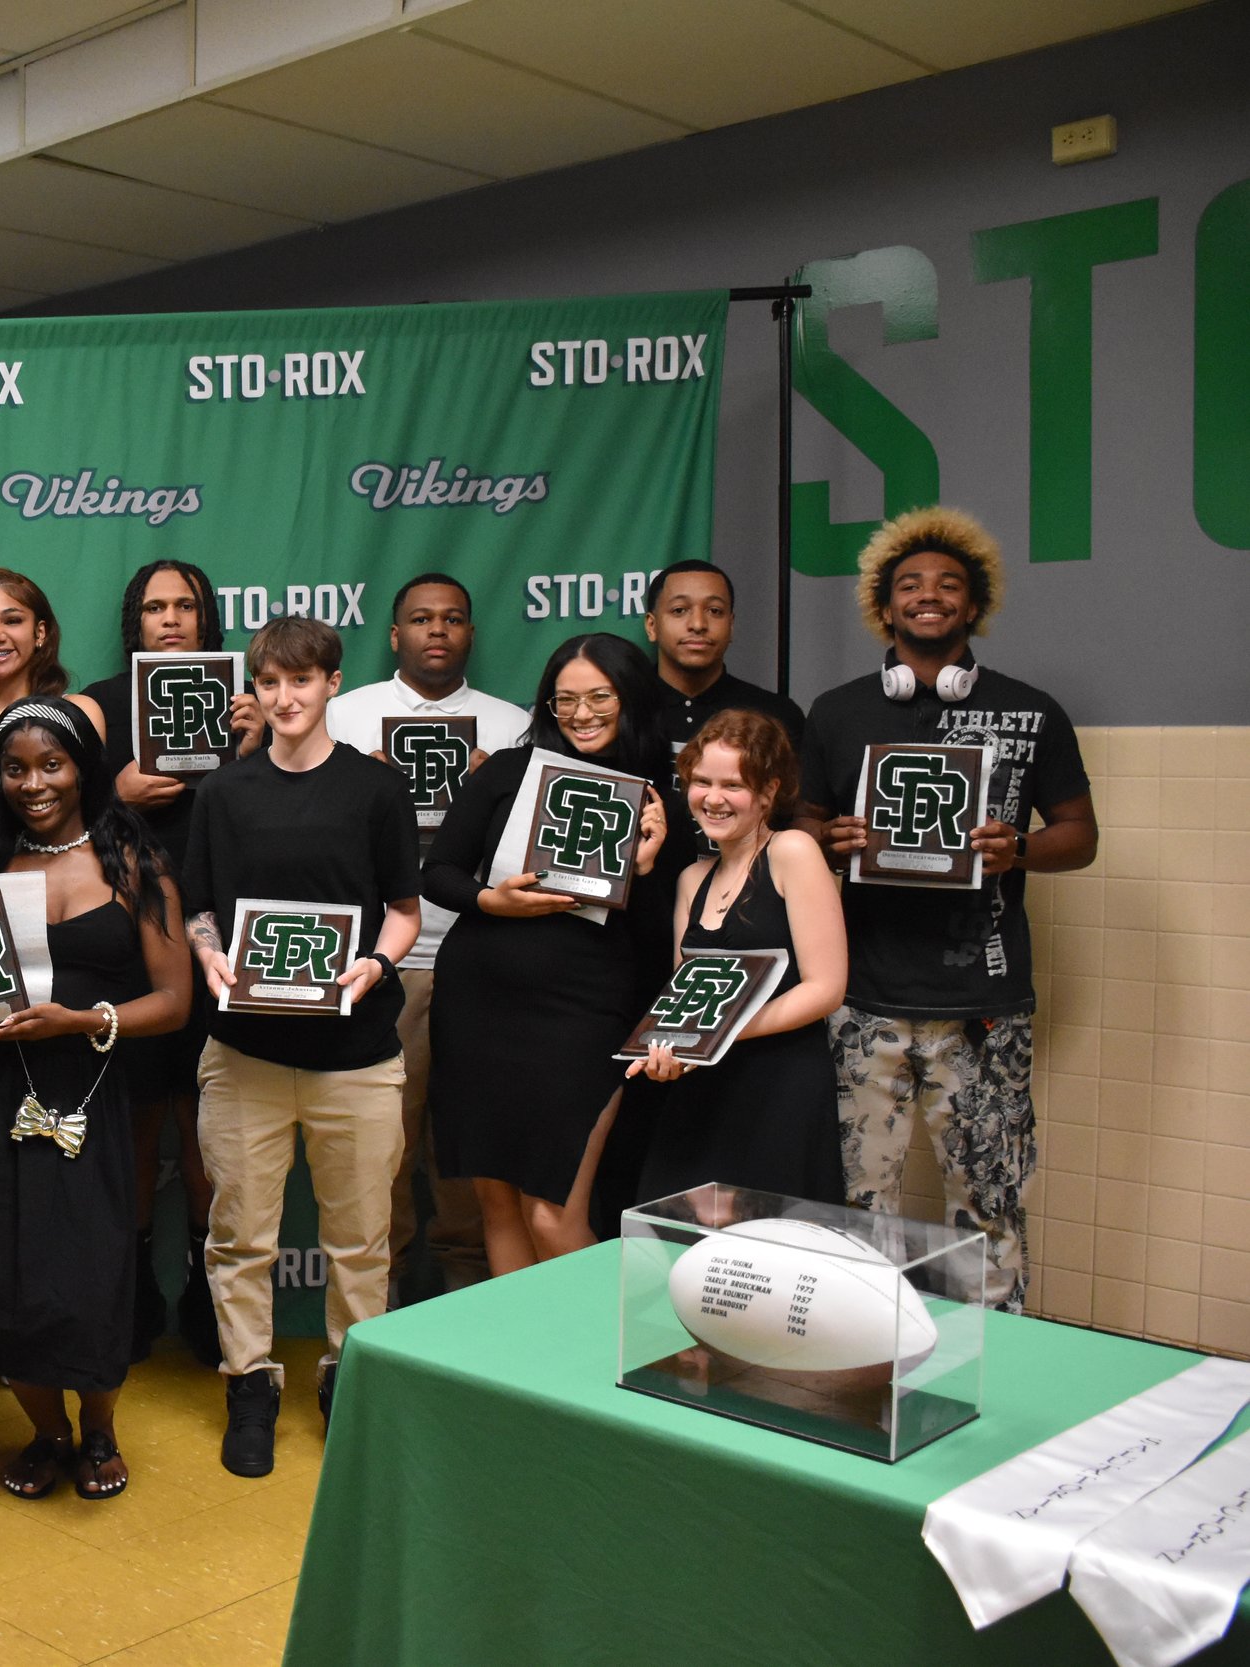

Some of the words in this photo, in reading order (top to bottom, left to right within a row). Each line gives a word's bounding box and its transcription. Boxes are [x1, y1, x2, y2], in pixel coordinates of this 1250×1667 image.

[0, 469, 201, 526] Vikings
[351, 459, 547, 514] Vikings
[936, 708, 1047, 734] ATHLETI
[999, 738, 1038, 764] EPT
[704, 1275, 728, 1286] CHARLIE
[729, 1279, 773, 1295] BRUECKMAN
[792, 1293, 813, 1304] 1957
[707, 1265, 721, 1275] CARL
[795, 1283, 815, 1295] 1973
[798, 1273, 818, 1284] 1979
[702, 1285, 722, 1295] FRANK
[722, 1288, 754, 1302] KOLINSKY
[789, 1304, 810, 1315] 1957
[716, 1297, 749, 1311] SANDUSKY
[786, 1314, 807, 1326] 1954
[786, 1325, 807, 1337] 1943
